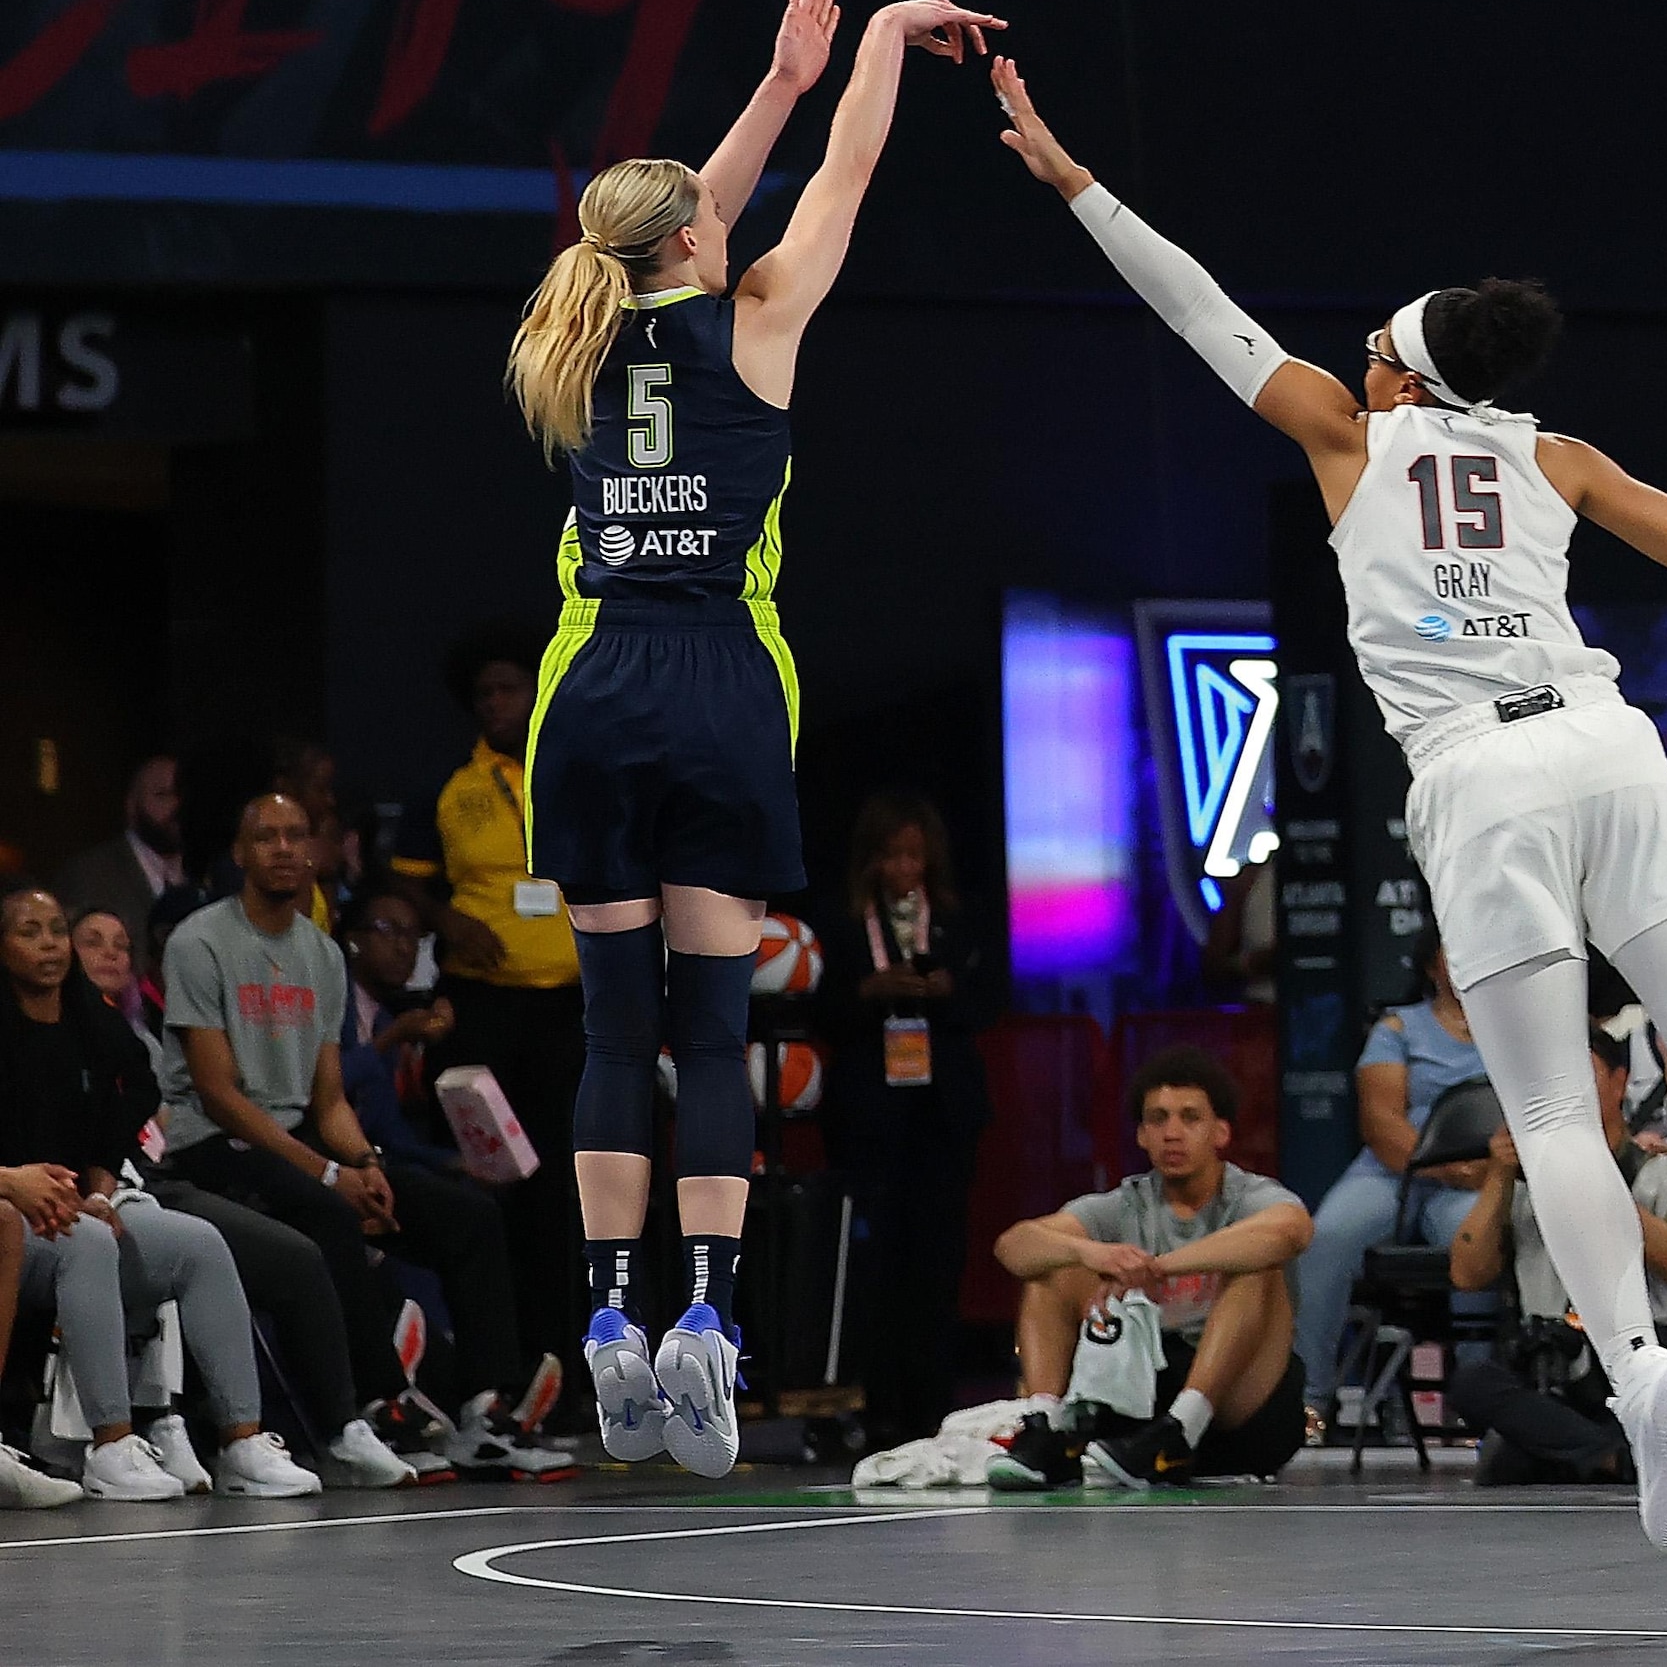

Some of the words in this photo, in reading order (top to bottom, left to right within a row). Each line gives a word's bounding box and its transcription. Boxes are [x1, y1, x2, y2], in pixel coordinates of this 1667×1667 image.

[627, 363, 674, 469] 5
[601, 475, 708, 515] BUECKERS
[1408, 454, 1505, 550] 15
[639, 529, 718, 555] AT&T
[1434, 563, 1490, 598] GRAY
[1462, 613, 1532, 638] AT&T
